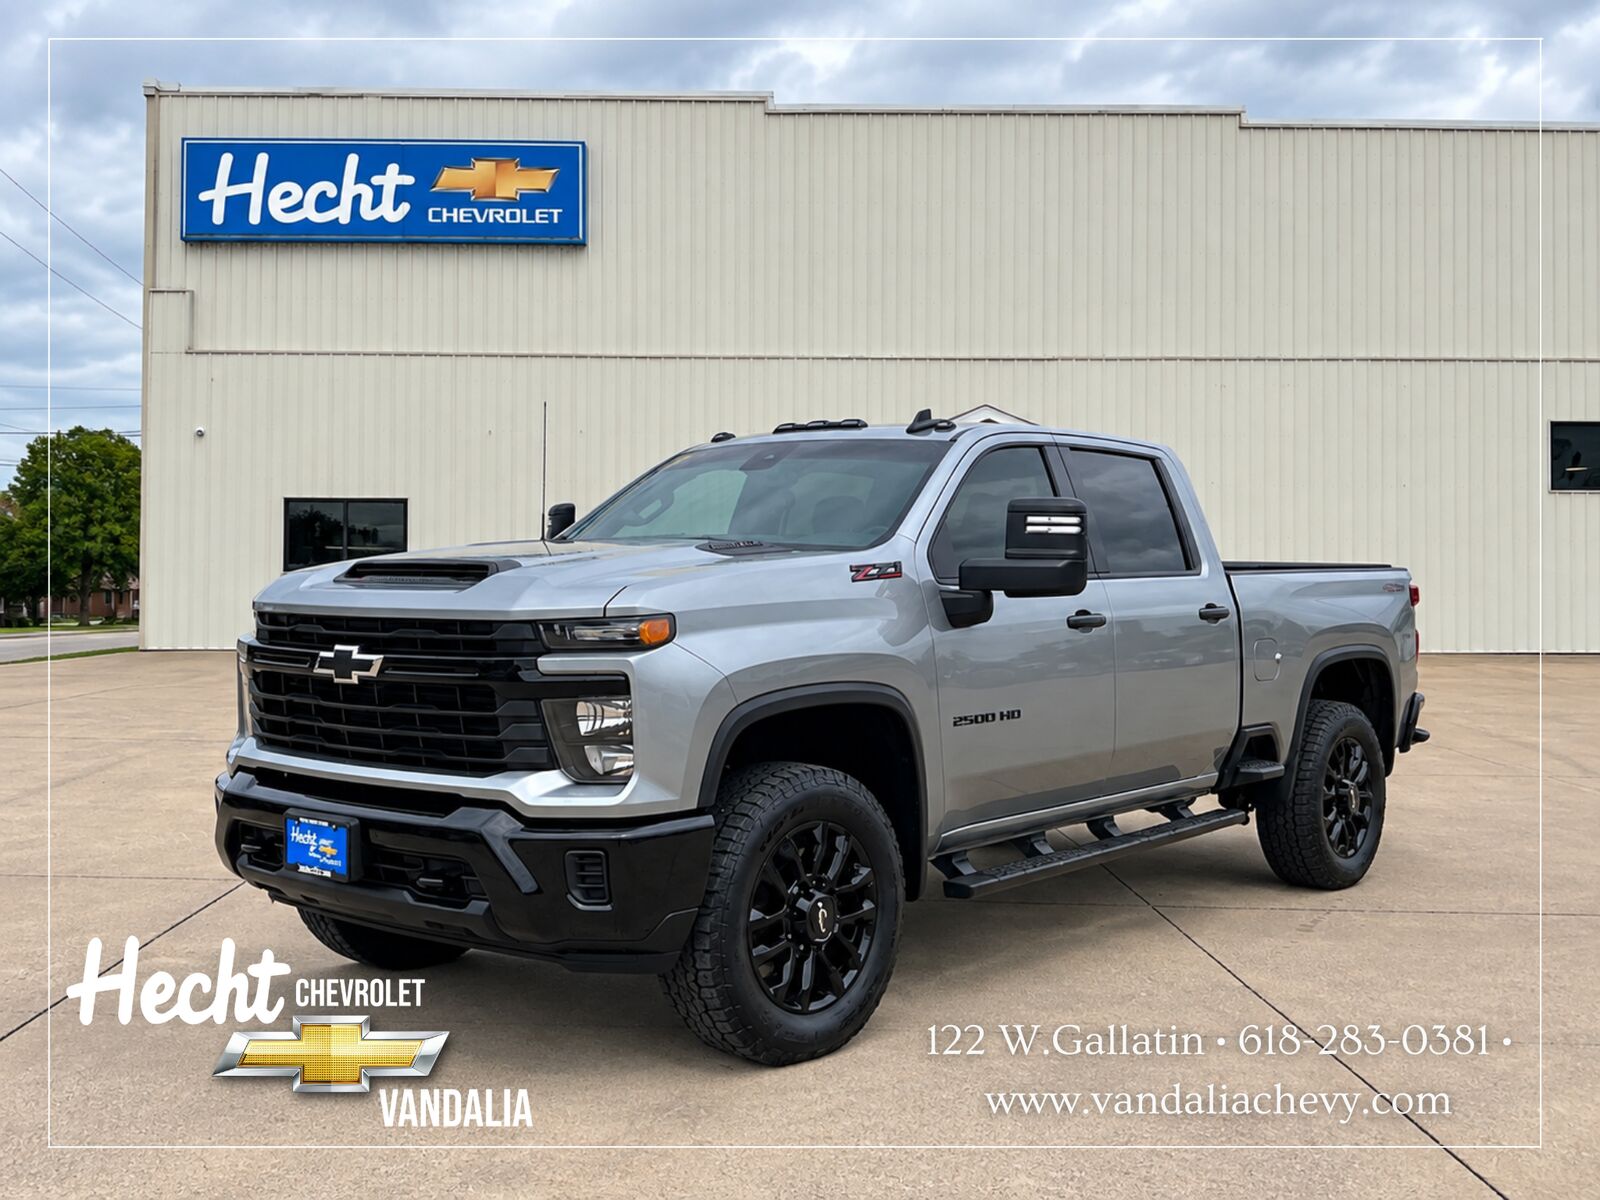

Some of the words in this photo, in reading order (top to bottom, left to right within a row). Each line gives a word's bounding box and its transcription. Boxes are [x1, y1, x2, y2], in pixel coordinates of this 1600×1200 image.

[199, 152, 415, 225] Hecht
[428, 207, 563, 224] CHEVROLET
[953, 712, 996, 727] 2500
[1000, 709, 1021, 722] HD
